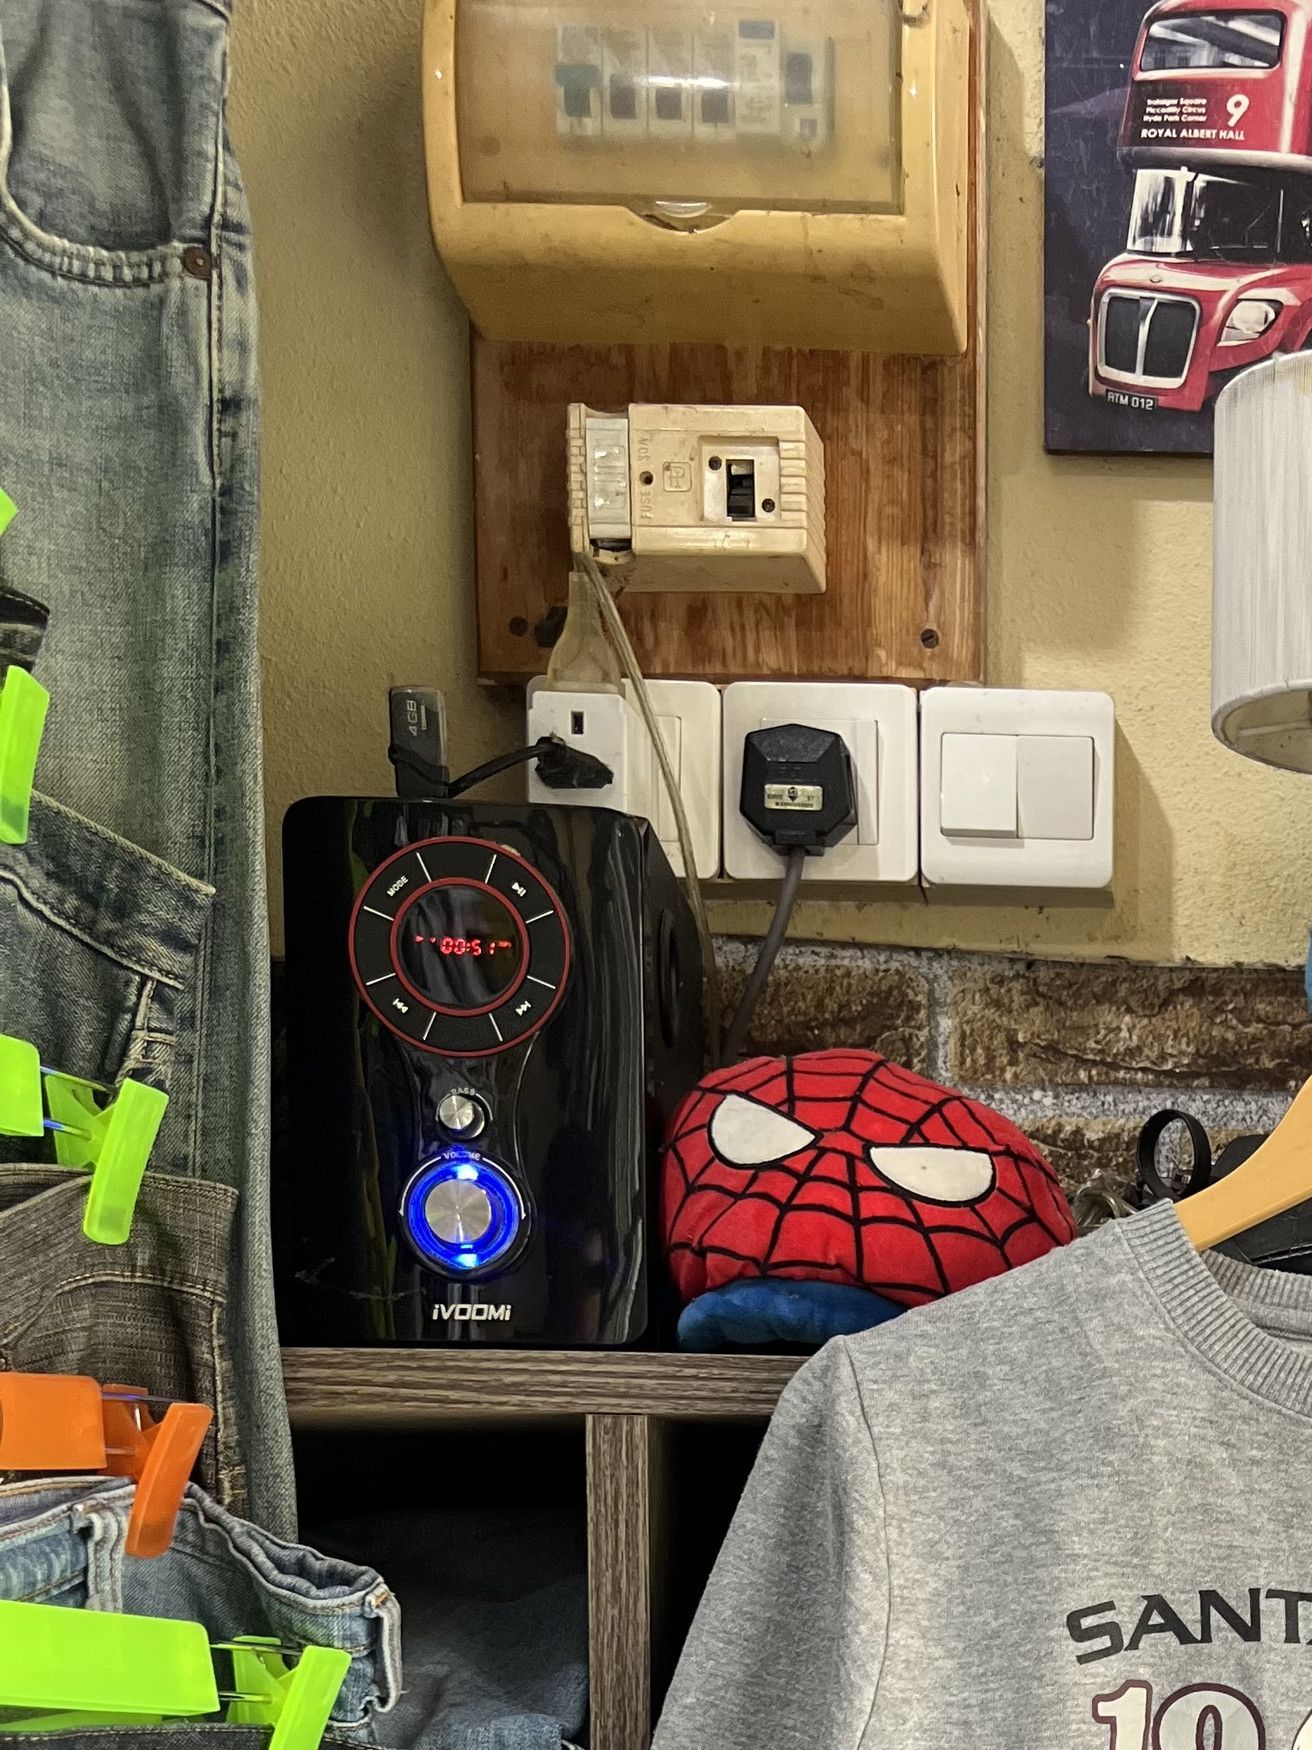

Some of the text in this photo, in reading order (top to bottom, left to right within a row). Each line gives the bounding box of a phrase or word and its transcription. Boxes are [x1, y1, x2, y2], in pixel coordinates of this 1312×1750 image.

[1226, 93, 1250, 128] 9
[1140, 128, 1245, 141] ROYAL ALBERT HALL
[1131, 396, 1154, 410] 012
[640, 490, 653, 520] FUSE
[387, 875, 409, 897] MODE
[441, 1150, 481, 1161] VOME
[432, 1304, 512, 1321] iVOOMi
